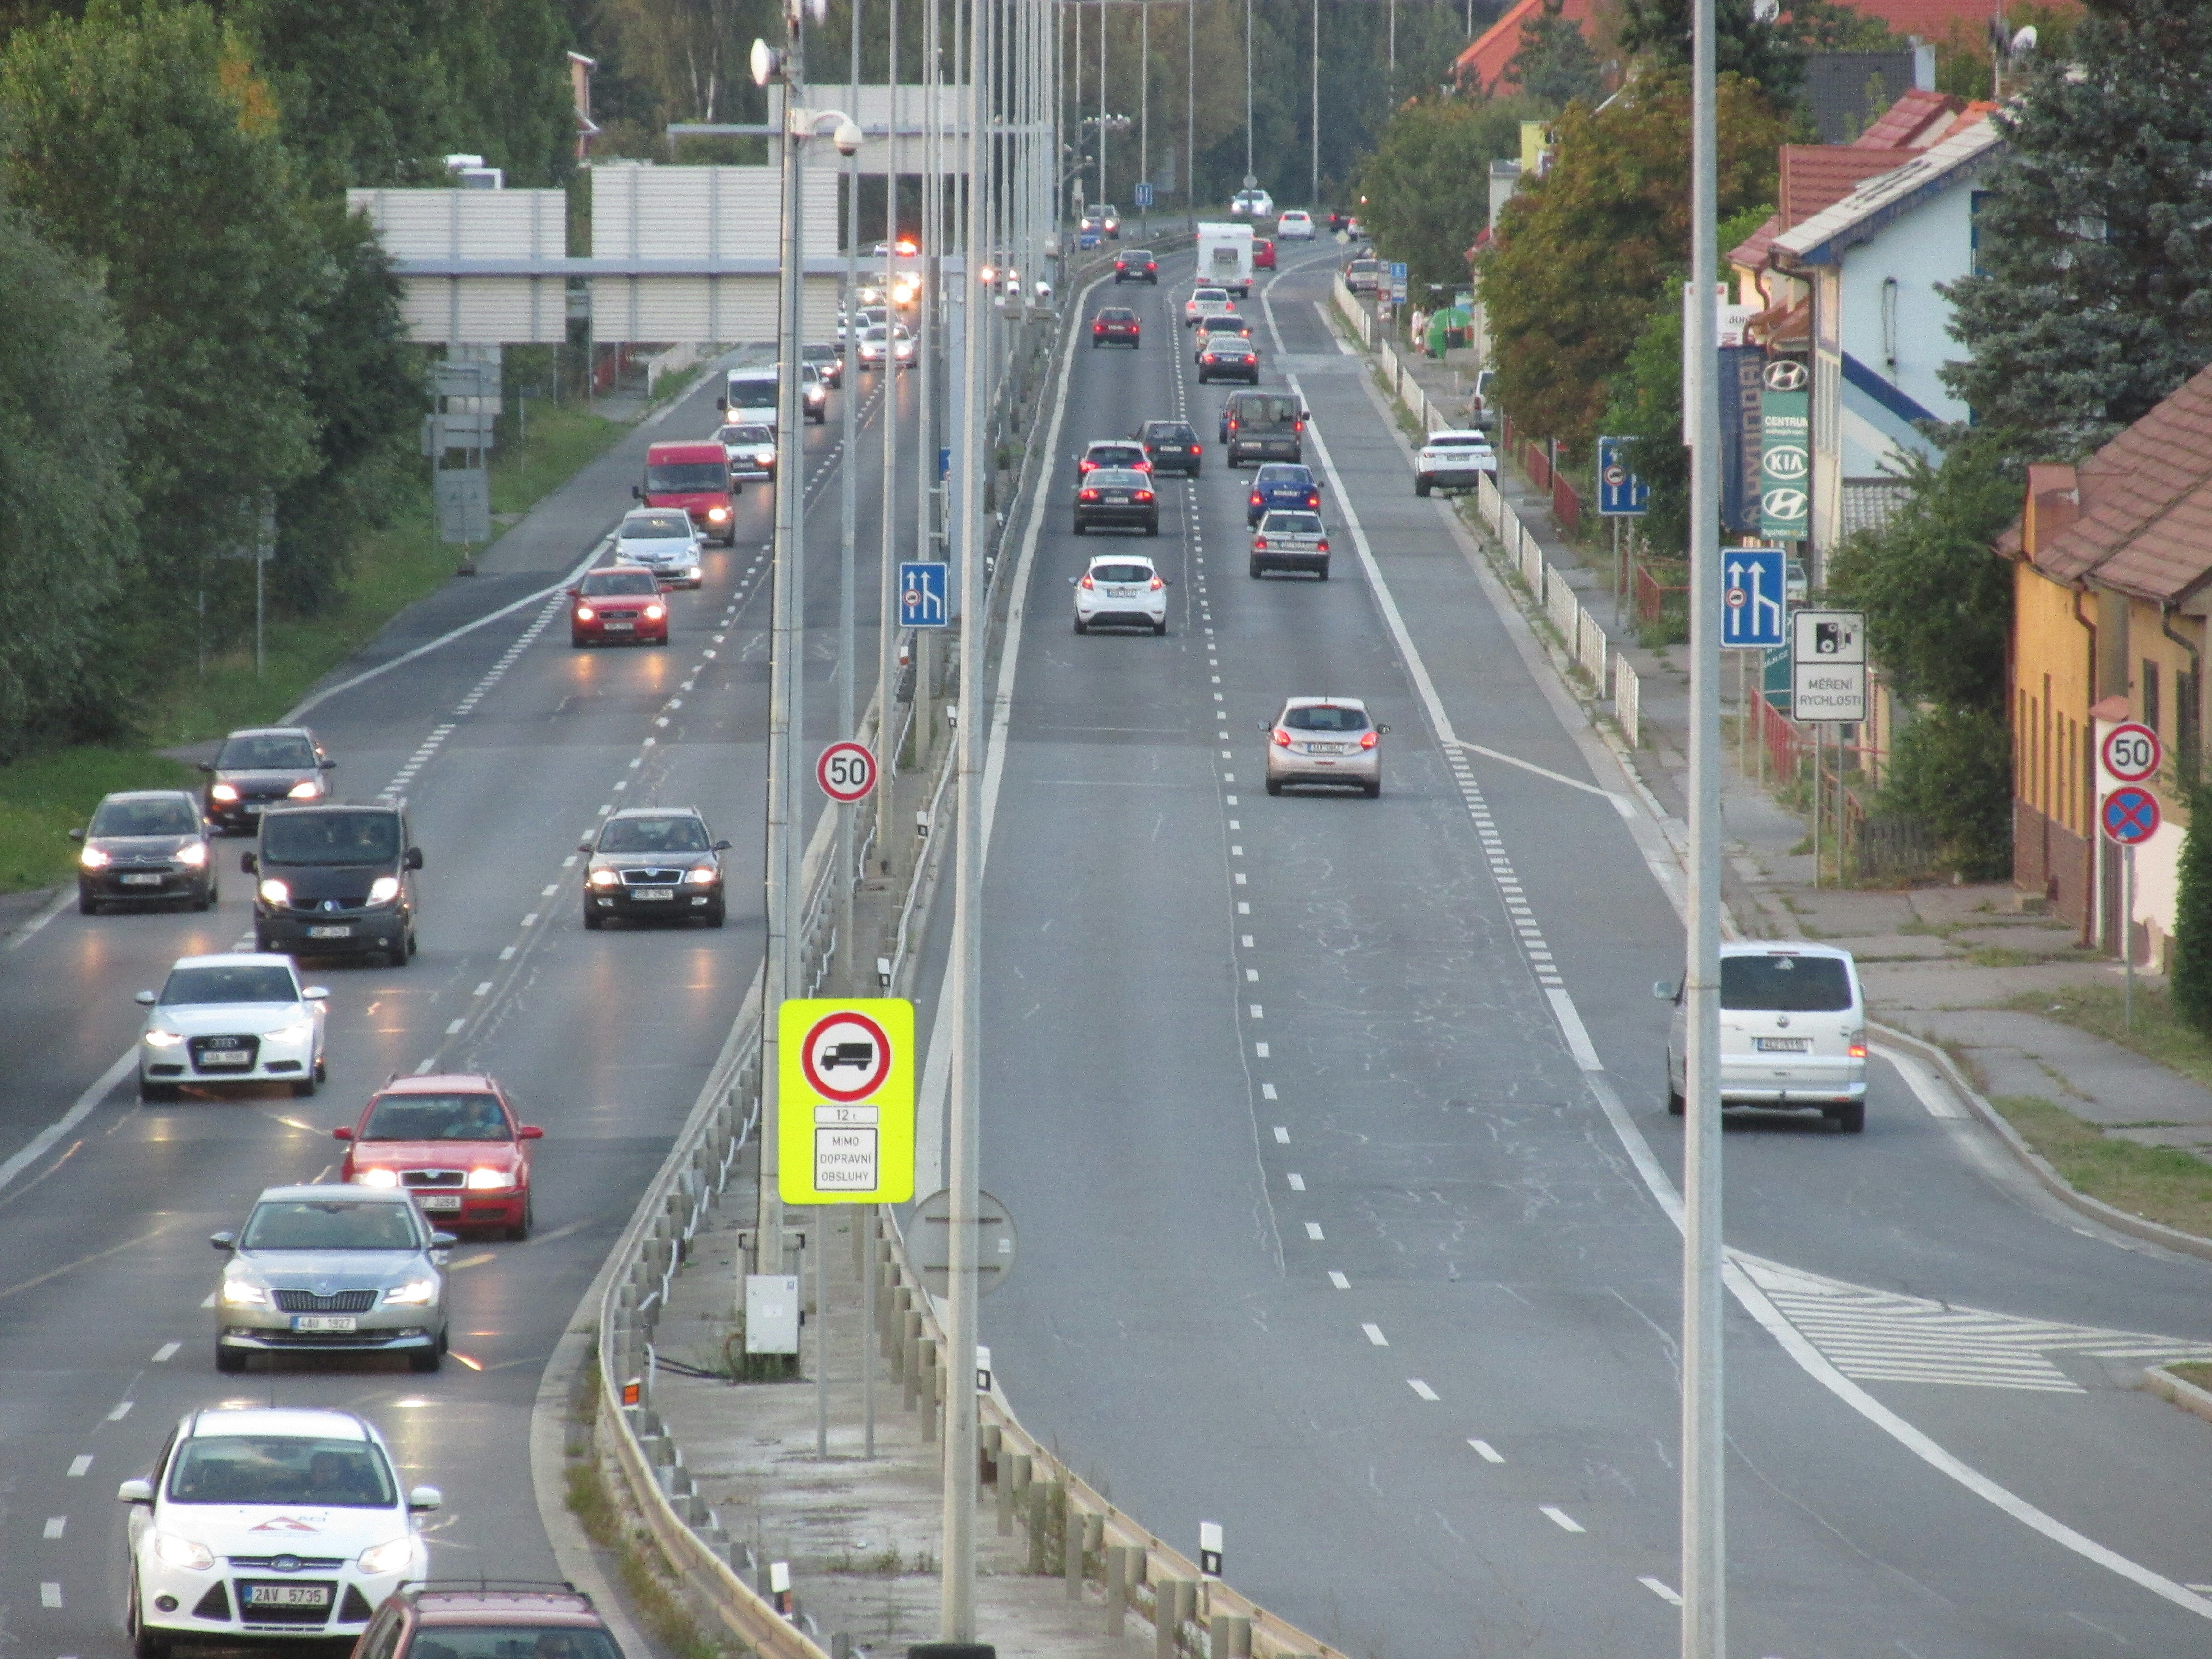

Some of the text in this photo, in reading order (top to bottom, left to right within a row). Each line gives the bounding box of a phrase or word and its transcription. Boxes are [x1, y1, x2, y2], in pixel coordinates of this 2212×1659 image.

[1770, 454, 1803, 471] KIA
[1808, 677, 1852, 690] MĚŘENÍ
[1800, 695, 1861, 706] RYCHLOSTI
[2116, 739, 2149, 766] 50
[831, 757, 865, 785] 50
[837, 1109, 856, 1121] 12 t
[832, 1136, 859, 1146] MIMO
[820, 1152, 871, 1164] DOPRAVNÍ
[822, 1172, 868, 1181] OBSLUHY
[328, 1318, 351, 1328] 1927
[254, 1588, 321, 1602] 2AV 5735
